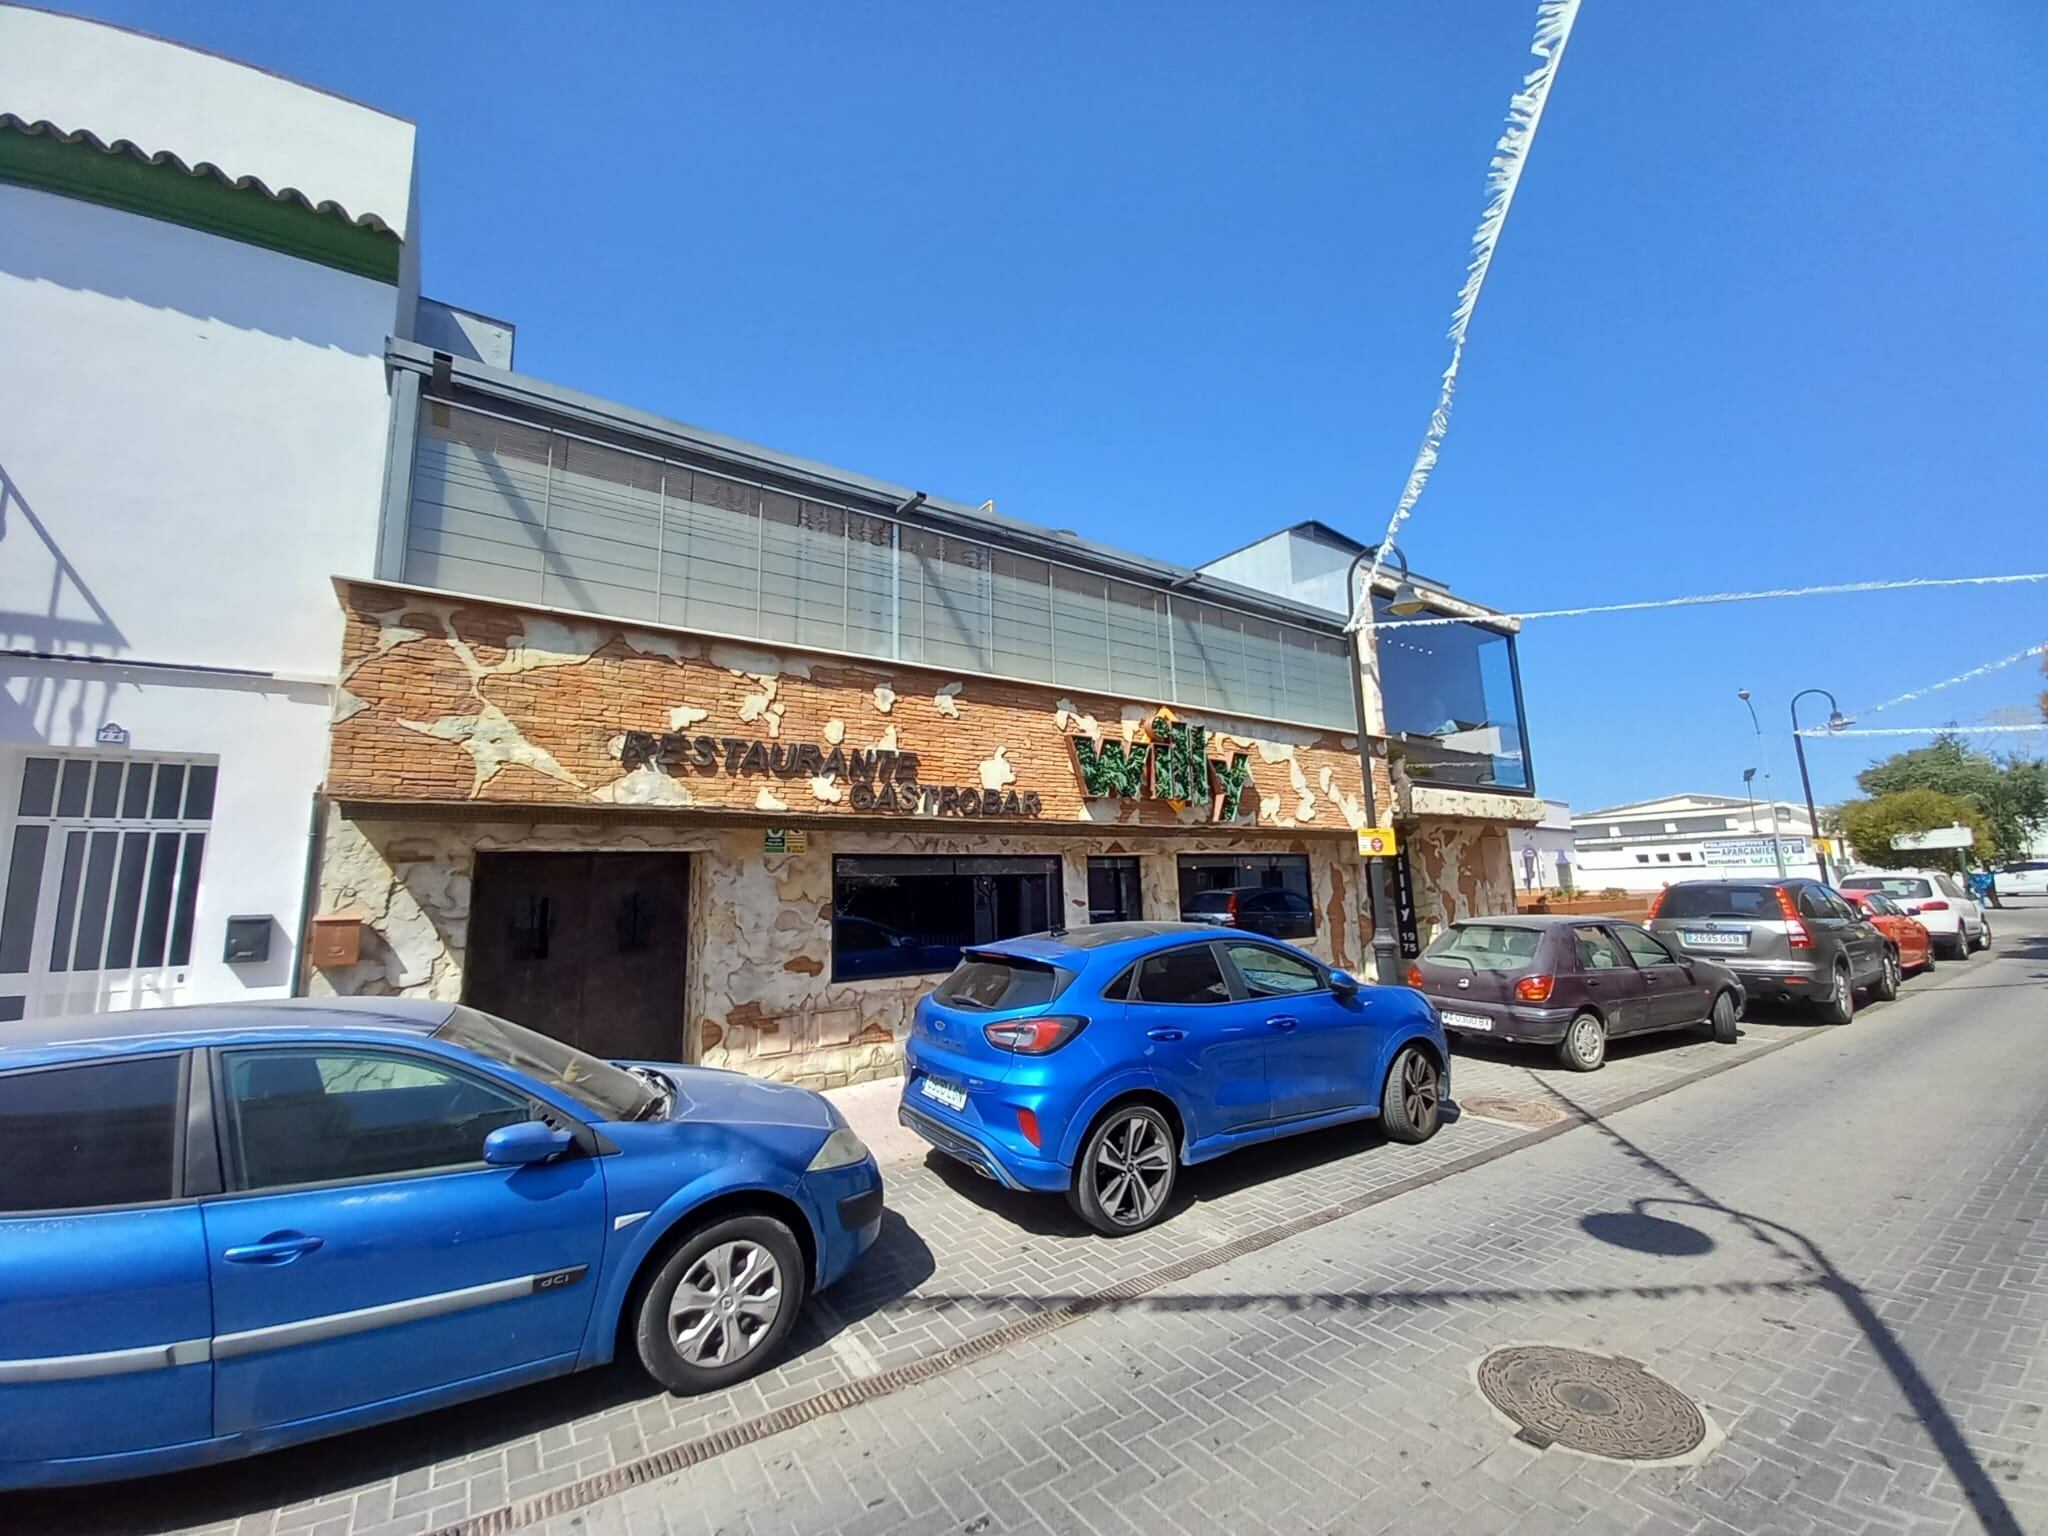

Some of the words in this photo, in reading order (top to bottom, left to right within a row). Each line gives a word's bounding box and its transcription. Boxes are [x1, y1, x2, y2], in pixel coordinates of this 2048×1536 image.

[622, 731, 920, 780] RESTAURANTE
[850, 780, 1042, 816] GASTROBAR
[1402, 932, 1415, 941] 19
[1403, 943, 1417, 952] 75
